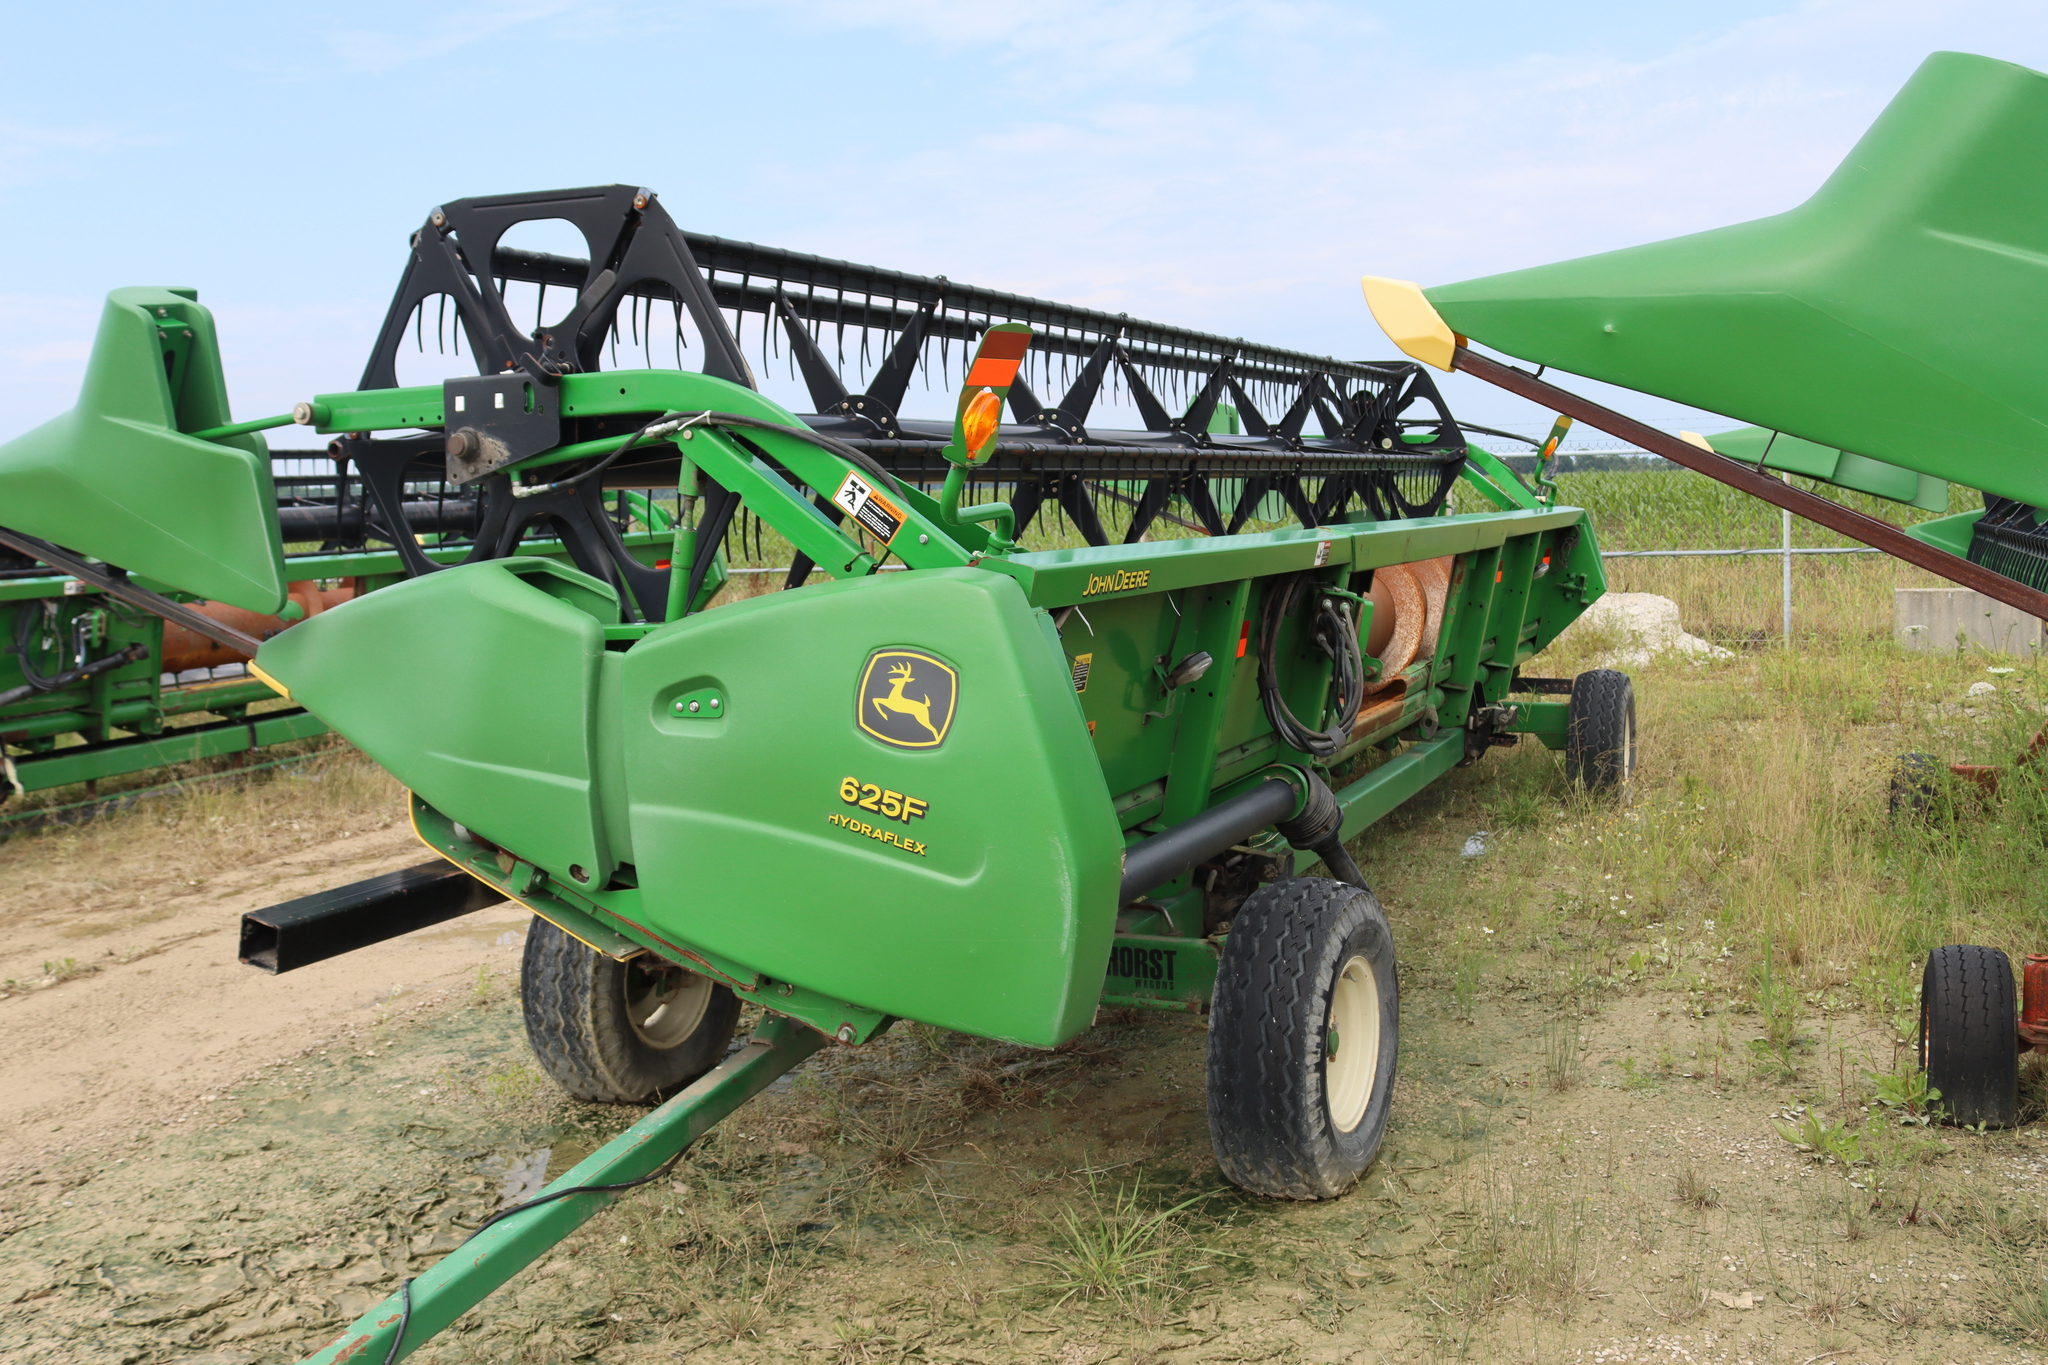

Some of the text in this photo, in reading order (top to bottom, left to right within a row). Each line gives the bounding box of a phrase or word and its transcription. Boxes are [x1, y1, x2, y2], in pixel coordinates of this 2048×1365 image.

[878, 496, 903, 520] WARNING
[1082, 569, 1151, 598] JOHN DEERE
[839, 776, 930, 825] 625F
[828, 814, 927, 857] HYDRAFLEX
[1106, 946, 1177, 980] HORST
[1134, 979, 1174, 991] WAGONS
